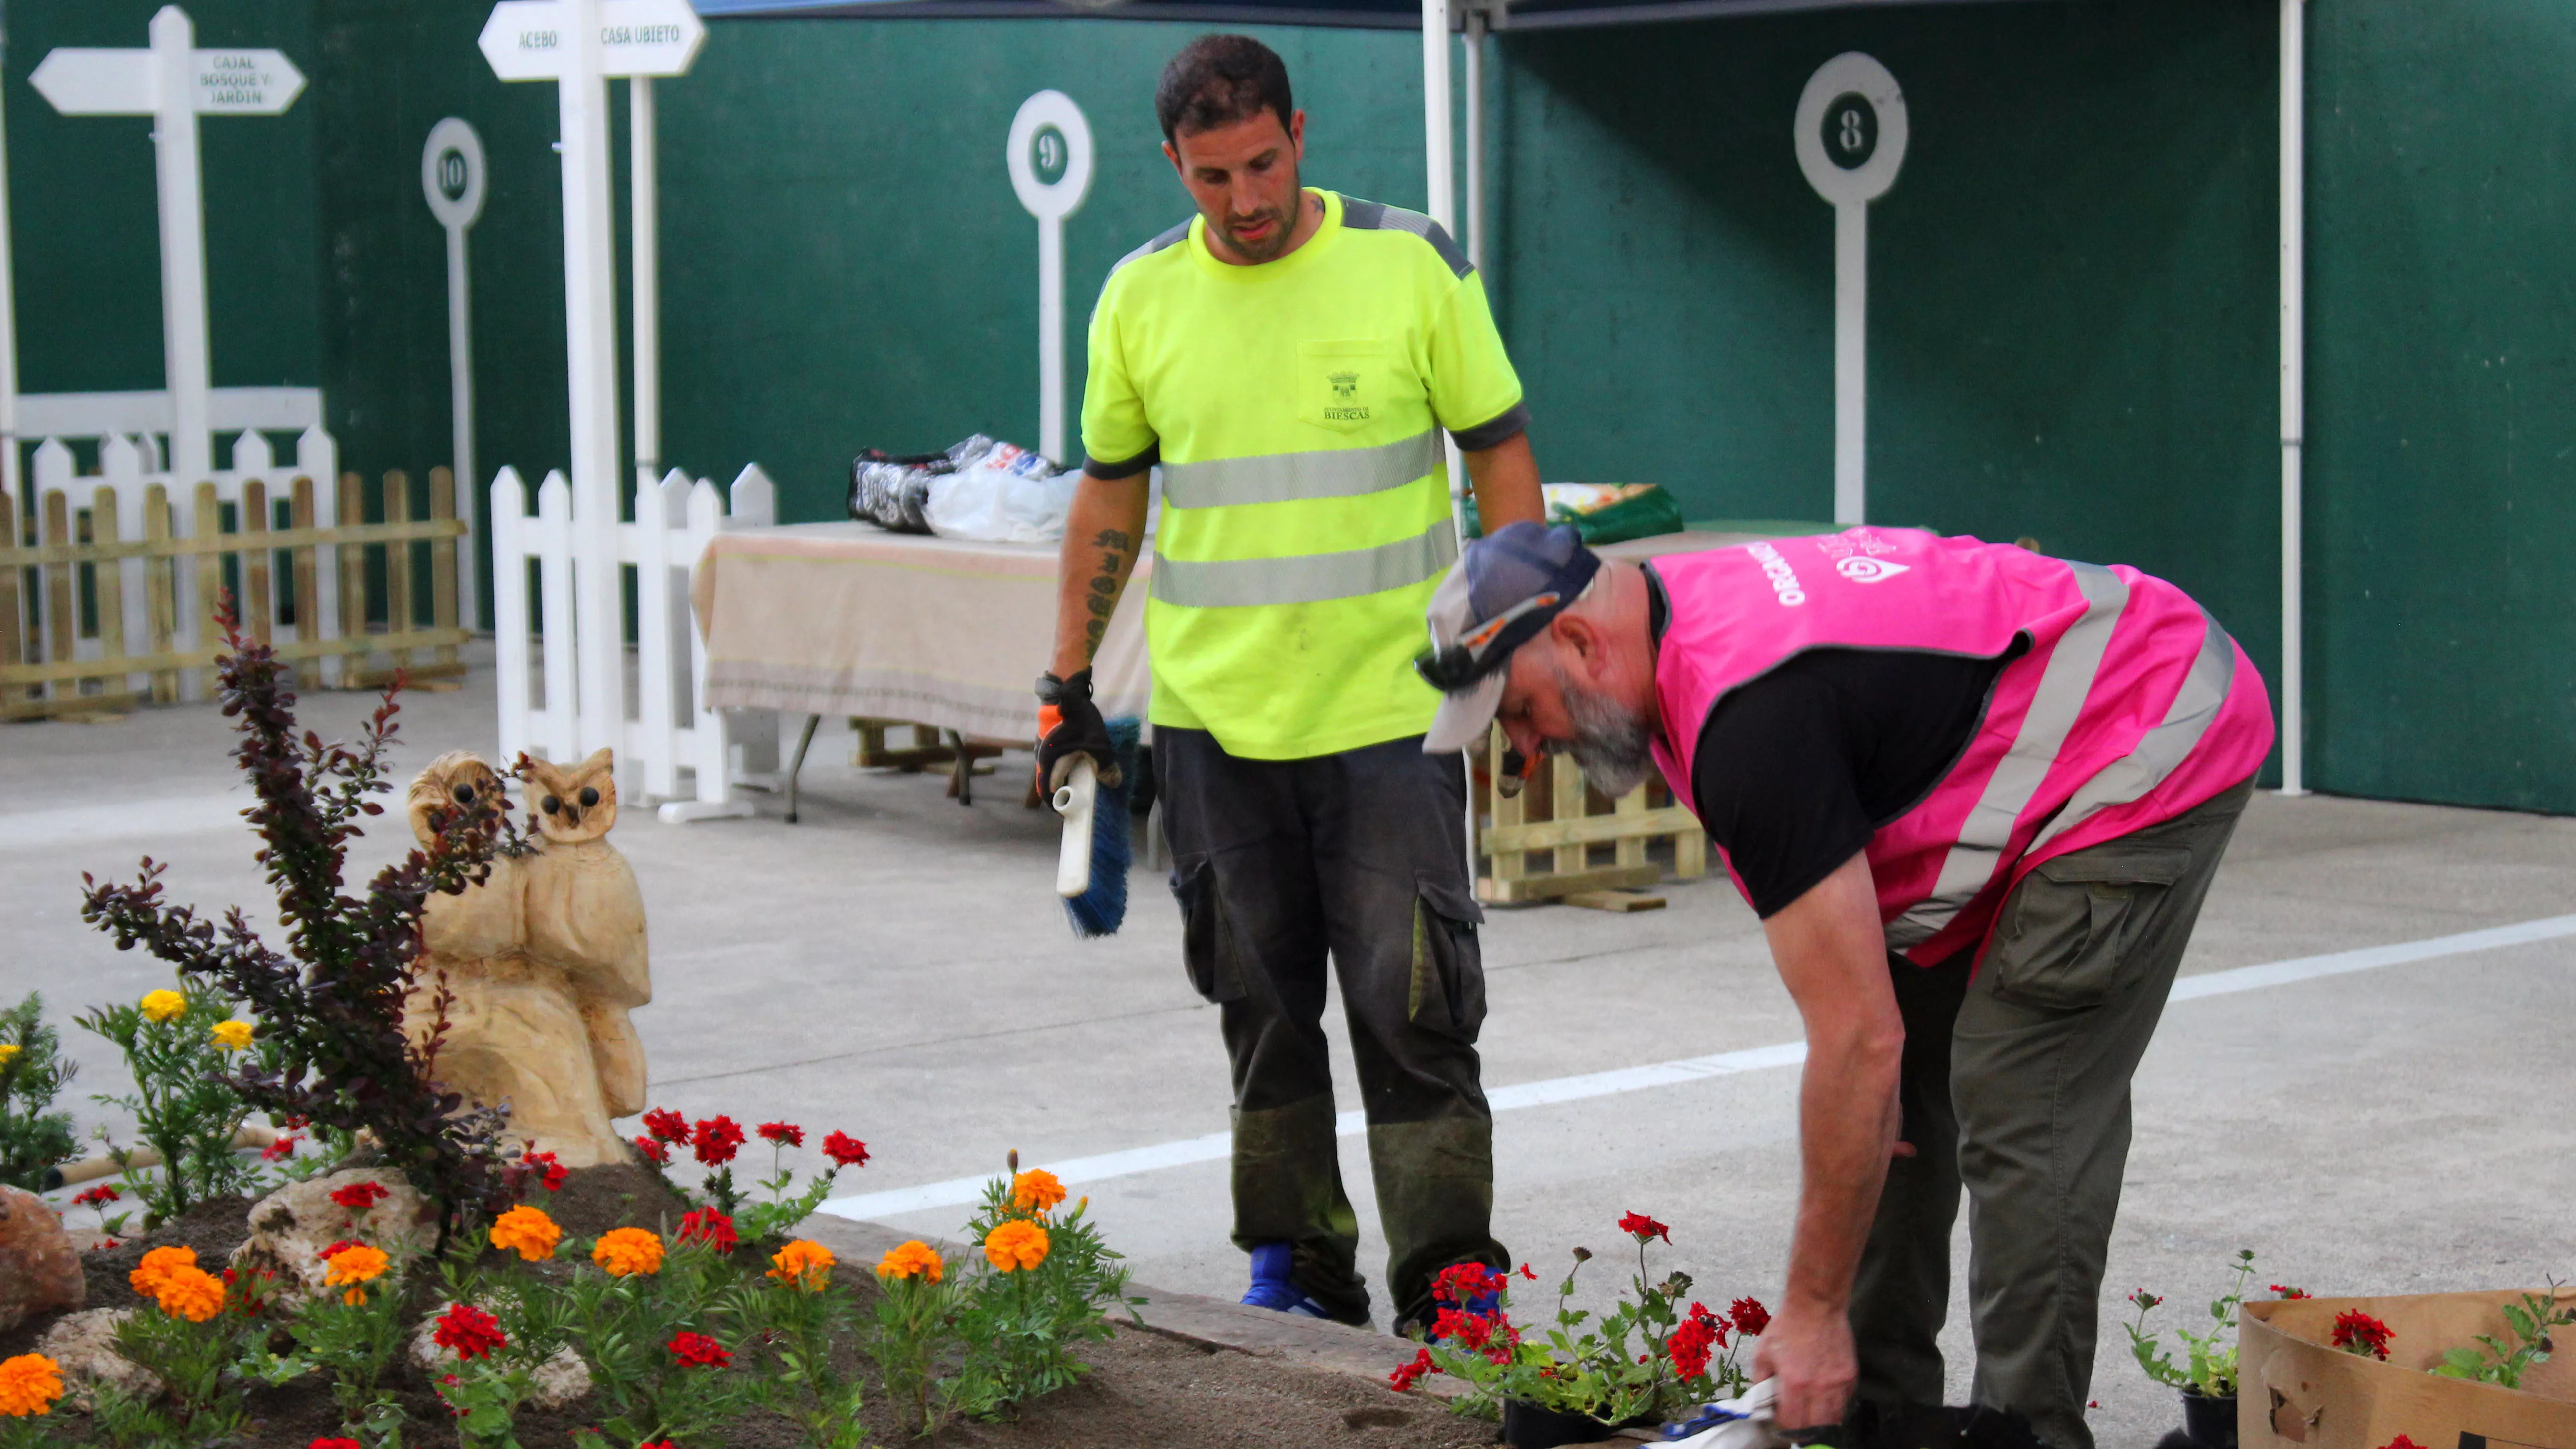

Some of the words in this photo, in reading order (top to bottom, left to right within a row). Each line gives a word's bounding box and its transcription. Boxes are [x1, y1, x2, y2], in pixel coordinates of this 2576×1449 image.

[518, 30, 557, 48] ACEBO
[601, 27, 631, 45] CASA
[635, 24, 680, 44] UBIETO
[213, 56, 255, 69] CAJAL
[200, 73, 257, 88] BOSQUE
[260, 73, 269, 86] Y
[210, 90, 261, 103] JARDIN
[1839, 109, 1862, 152] 8
[1038, 135, 1056, 169] 9
[441, 157, 463, 188] 10
[1324, 411, 1369, 420] BIESCAS
